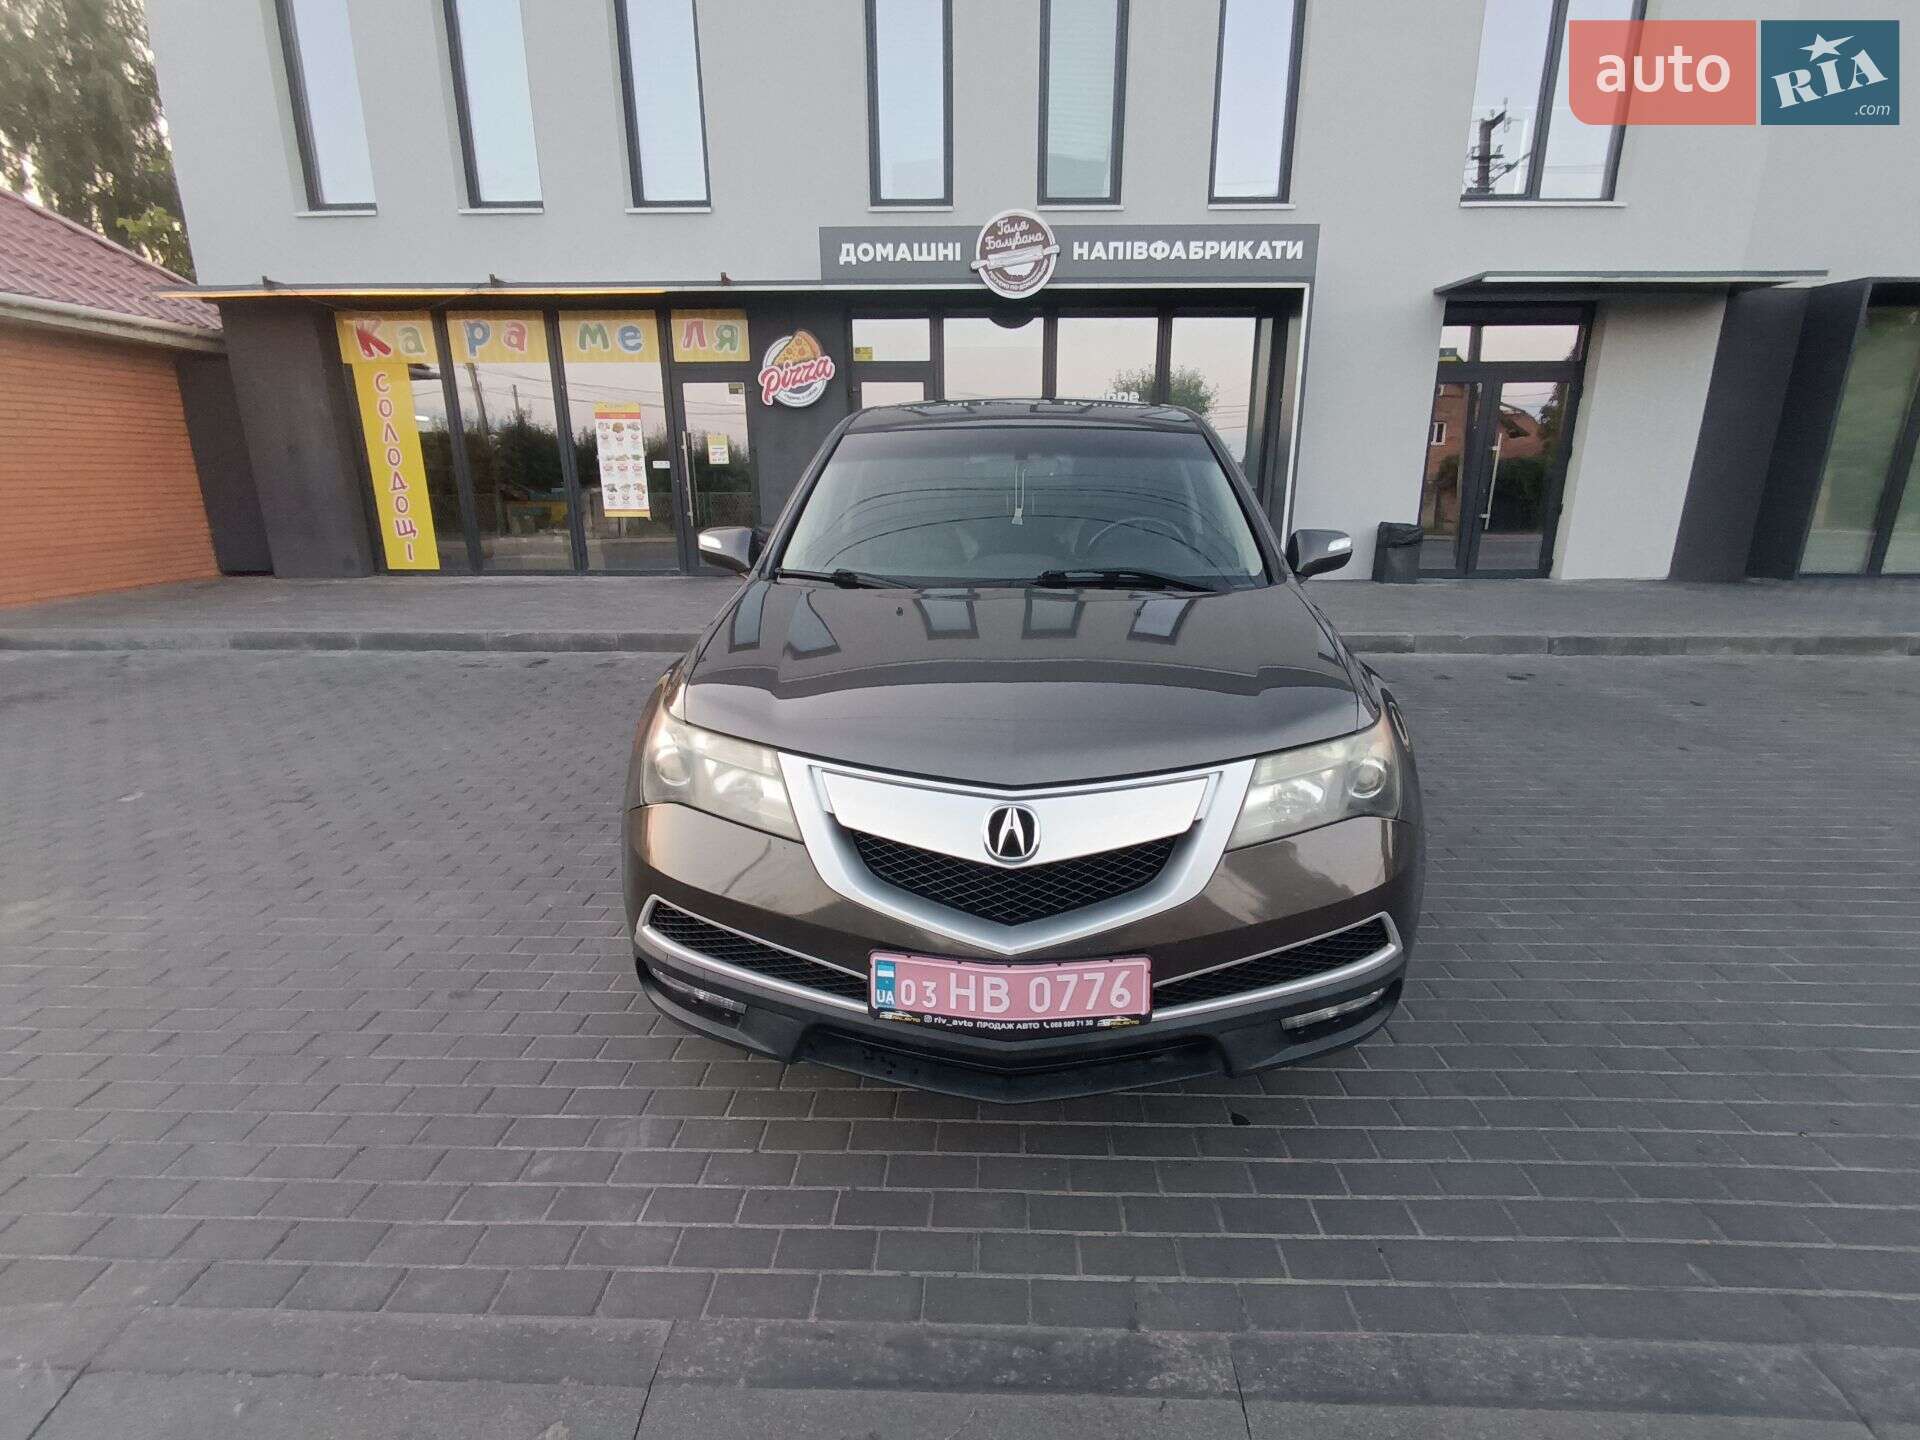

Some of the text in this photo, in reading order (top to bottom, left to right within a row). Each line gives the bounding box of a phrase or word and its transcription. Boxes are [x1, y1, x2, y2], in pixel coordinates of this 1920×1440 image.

[996, 217, 1029, 236] Галя
[984, 231, 1046, 251] Балувана
[1072, 239, 1305, 261] НАПІВФАБРИКАТИ
[838, 241, 962, 265] ДОМАШНІ
[374, 372, 418, 562] СОЛОДОЩІ
[876, 989, 895, 1005] UA
[949, 972, 1011, 1014] HB
[1028, 970, 1132, 1014] 0776
[976, 1020, 1014, 1031] ПРОДАЖ
[1016, 1021, 1040, 1030] АВТО
